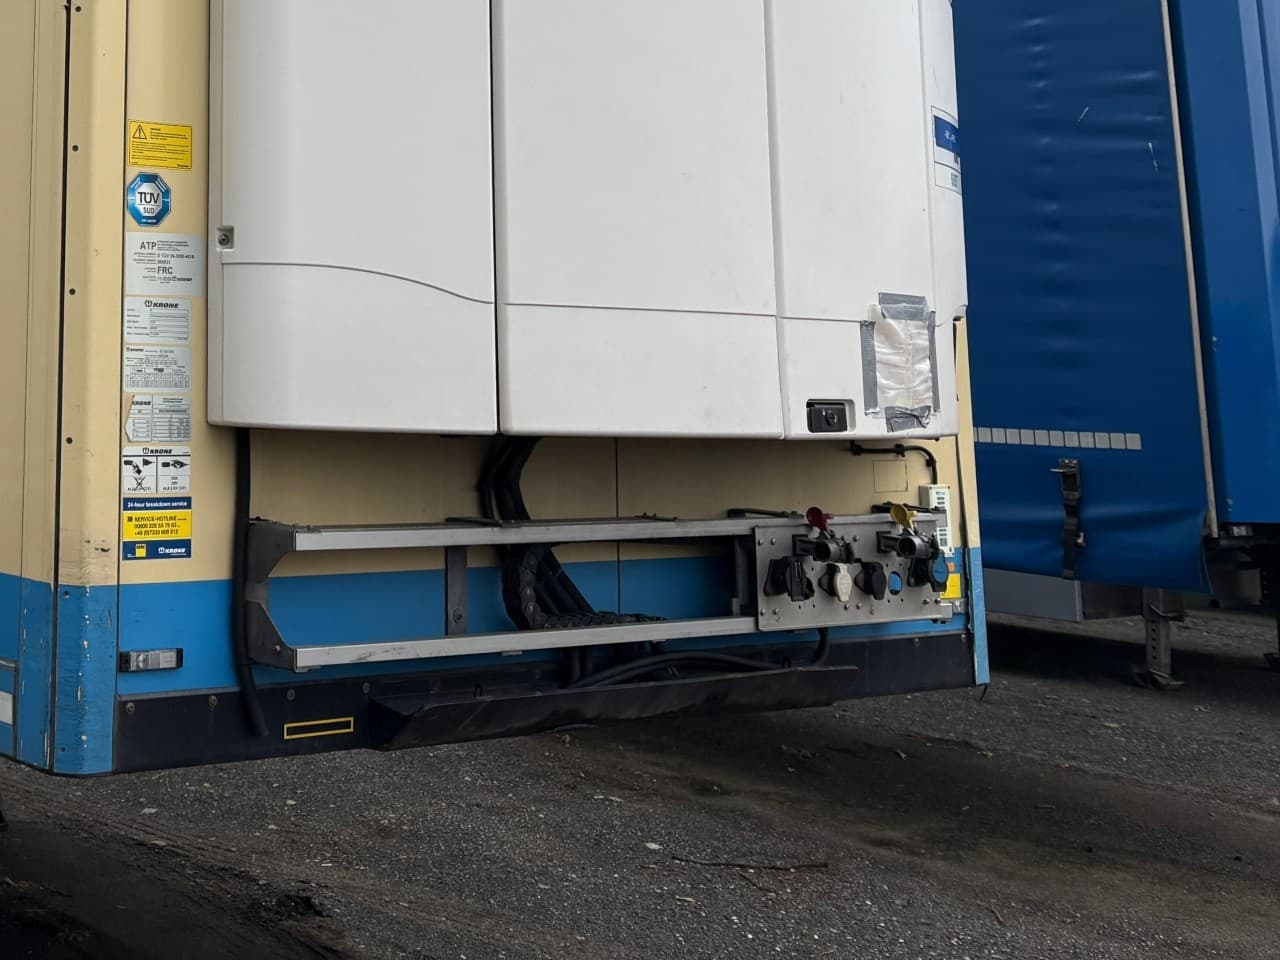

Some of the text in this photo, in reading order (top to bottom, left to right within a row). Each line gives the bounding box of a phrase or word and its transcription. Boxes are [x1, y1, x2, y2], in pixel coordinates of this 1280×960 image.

[137, 191, 160, 204] TÜV
[140, 241, 157, 250] ATP
[157, 266, 173, 275] FRC
